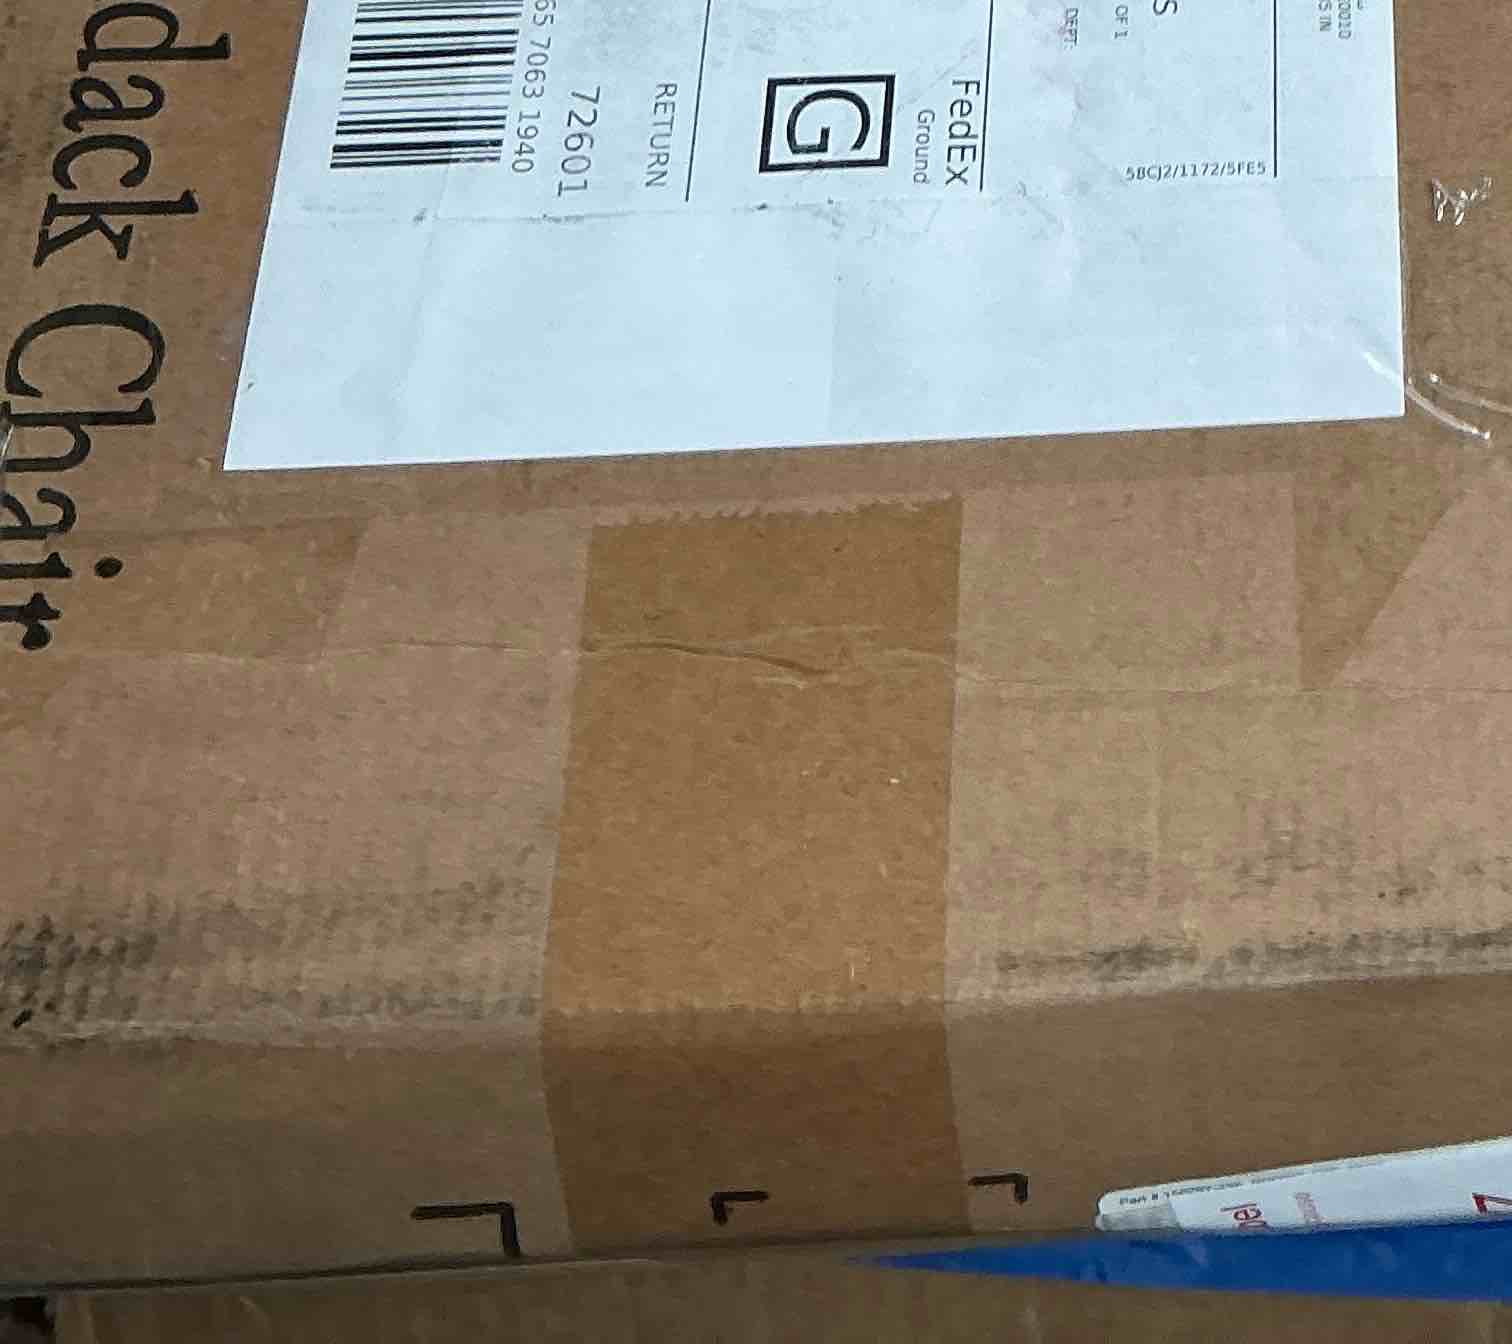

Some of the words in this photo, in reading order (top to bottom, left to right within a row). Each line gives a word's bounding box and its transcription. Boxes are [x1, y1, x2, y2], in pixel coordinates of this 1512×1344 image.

[1065, 7, 1078, 50] DEPT:
[1114, 31, 1128, 39] 1
[1115, 6, 1129, 26] OF
[1318, 16, 1331, 32] IN
[522, 36, 551, 98] 7063
[511, 110, 540, 174] 1940
[557, 86, 601, 196] 72601
[645, 82, 678, 189] RETURN
[786, 89, 870, 155] G
[912, 108, 934, 184] Ground
[944, 79, 981, 185] FedEx
[0, 304, 165, 650] Chair
